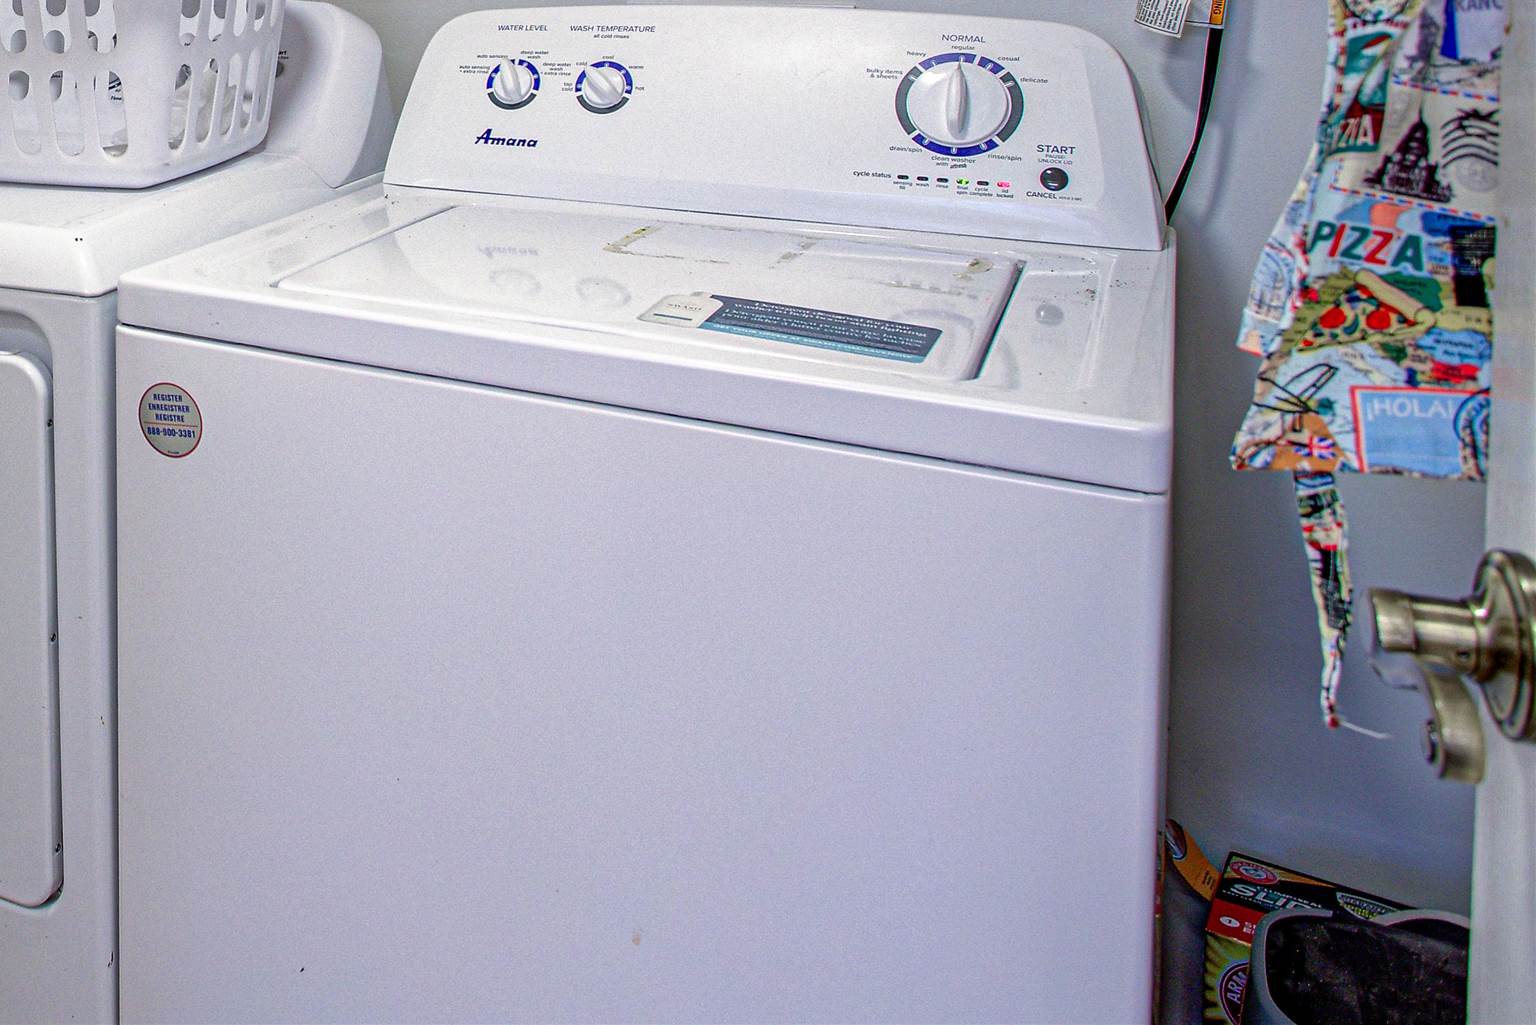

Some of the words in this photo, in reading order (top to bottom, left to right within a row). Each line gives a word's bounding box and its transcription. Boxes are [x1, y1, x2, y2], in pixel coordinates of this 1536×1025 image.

[497, 24, 524, 32] WATER
[525, 24, 548, 32] LEVEL
[596, 25, 656, 33] TEMPERATURE
[941, 34, 986, 44] NORMAL
[474, 128, 538, 148] Amana
[889, 145, 922, 153] drain/spin
[1036, 144, 1076, 154] START
[951, 156, 976, 164] washer
[987, 153, 1022, 162] rinse/spin
[1026, 191, 1057, 199] CANCEL
[1308, 220, 1424, 272] PIZZA
[153, 393, 183, 402] REGISTER
[148, 403, 190, 413] ENREGISTRER
[155, 413, 185, 423] REGISTRE
